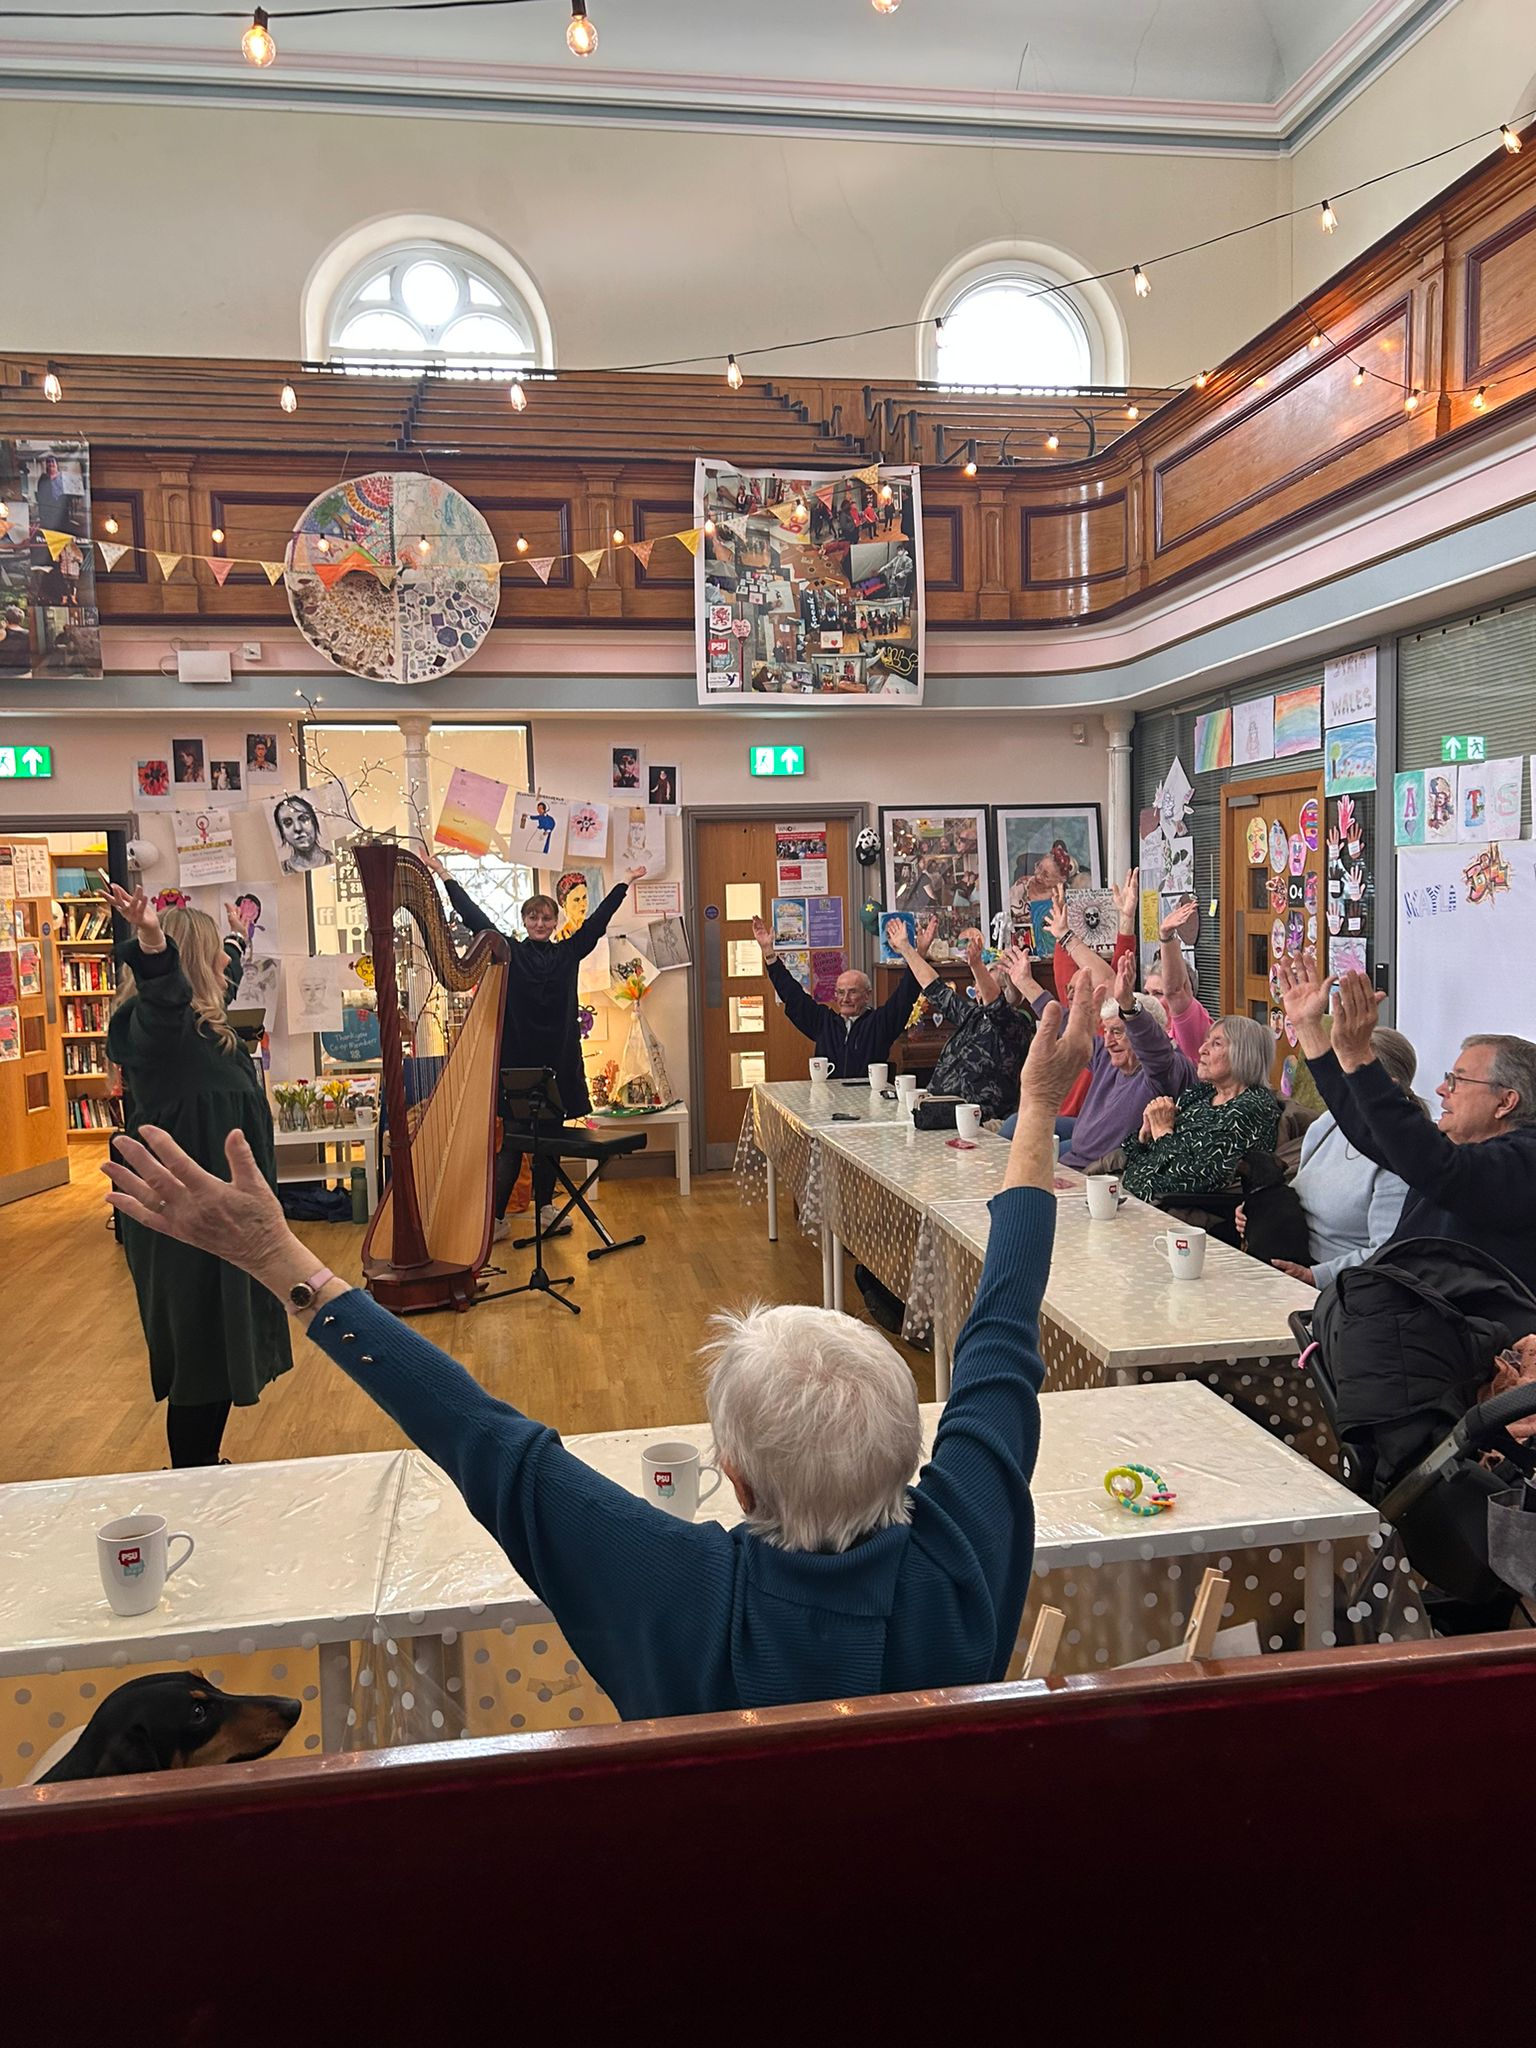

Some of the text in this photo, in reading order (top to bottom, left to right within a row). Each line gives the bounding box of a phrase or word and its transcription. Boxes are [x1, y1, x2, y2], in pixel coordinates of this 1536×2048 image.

[711, 642, 727, 651] PSU
[1331, 687, 1372, 717] WALES
[121, 1551, 138, 1562] PSU
